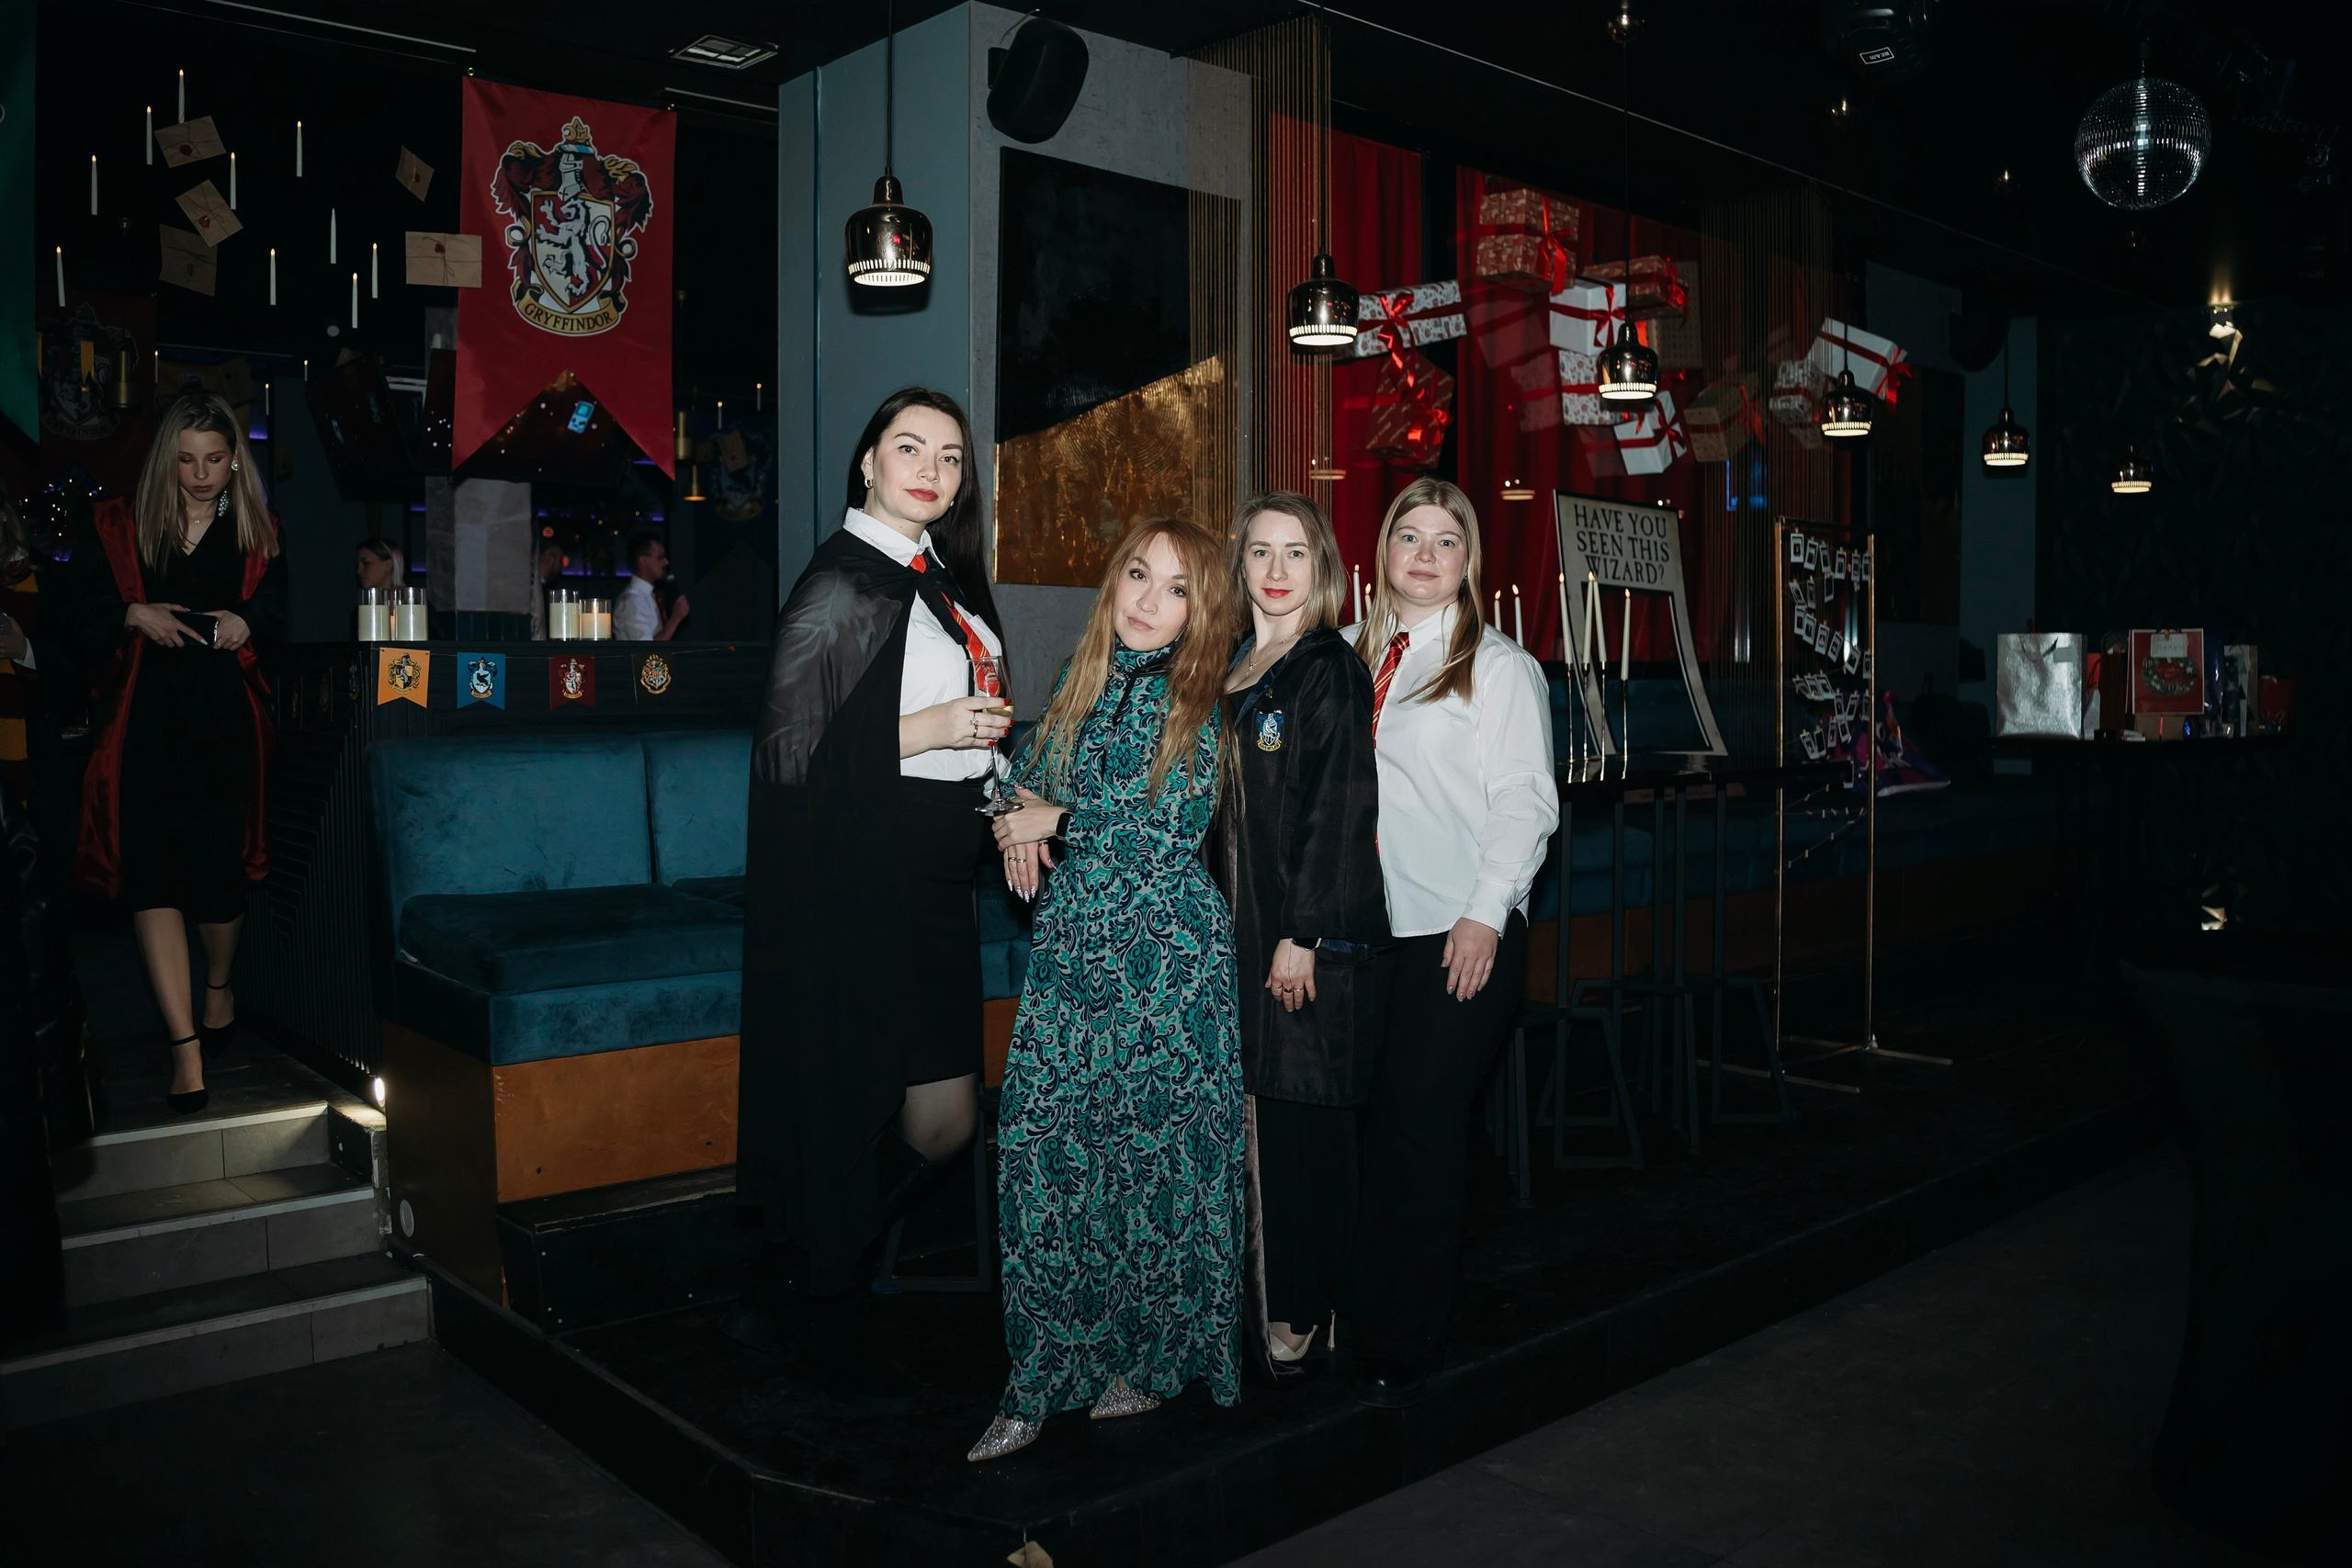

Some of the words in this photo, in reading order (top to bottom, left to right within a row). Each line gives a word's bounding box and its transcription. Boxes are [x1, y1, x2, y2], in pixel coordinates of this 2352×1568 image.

[524, 303, 613, 332] GRYFFINDOR
[1574, 504, 1623, 533] HAVE
[1628, 513, 1667, 538] YOU
[1577, 531, 1623, 557] SEEN
[1628, 536, 1669, 562] THIS
[1585, 555, 1665, 585] WIZARD?
